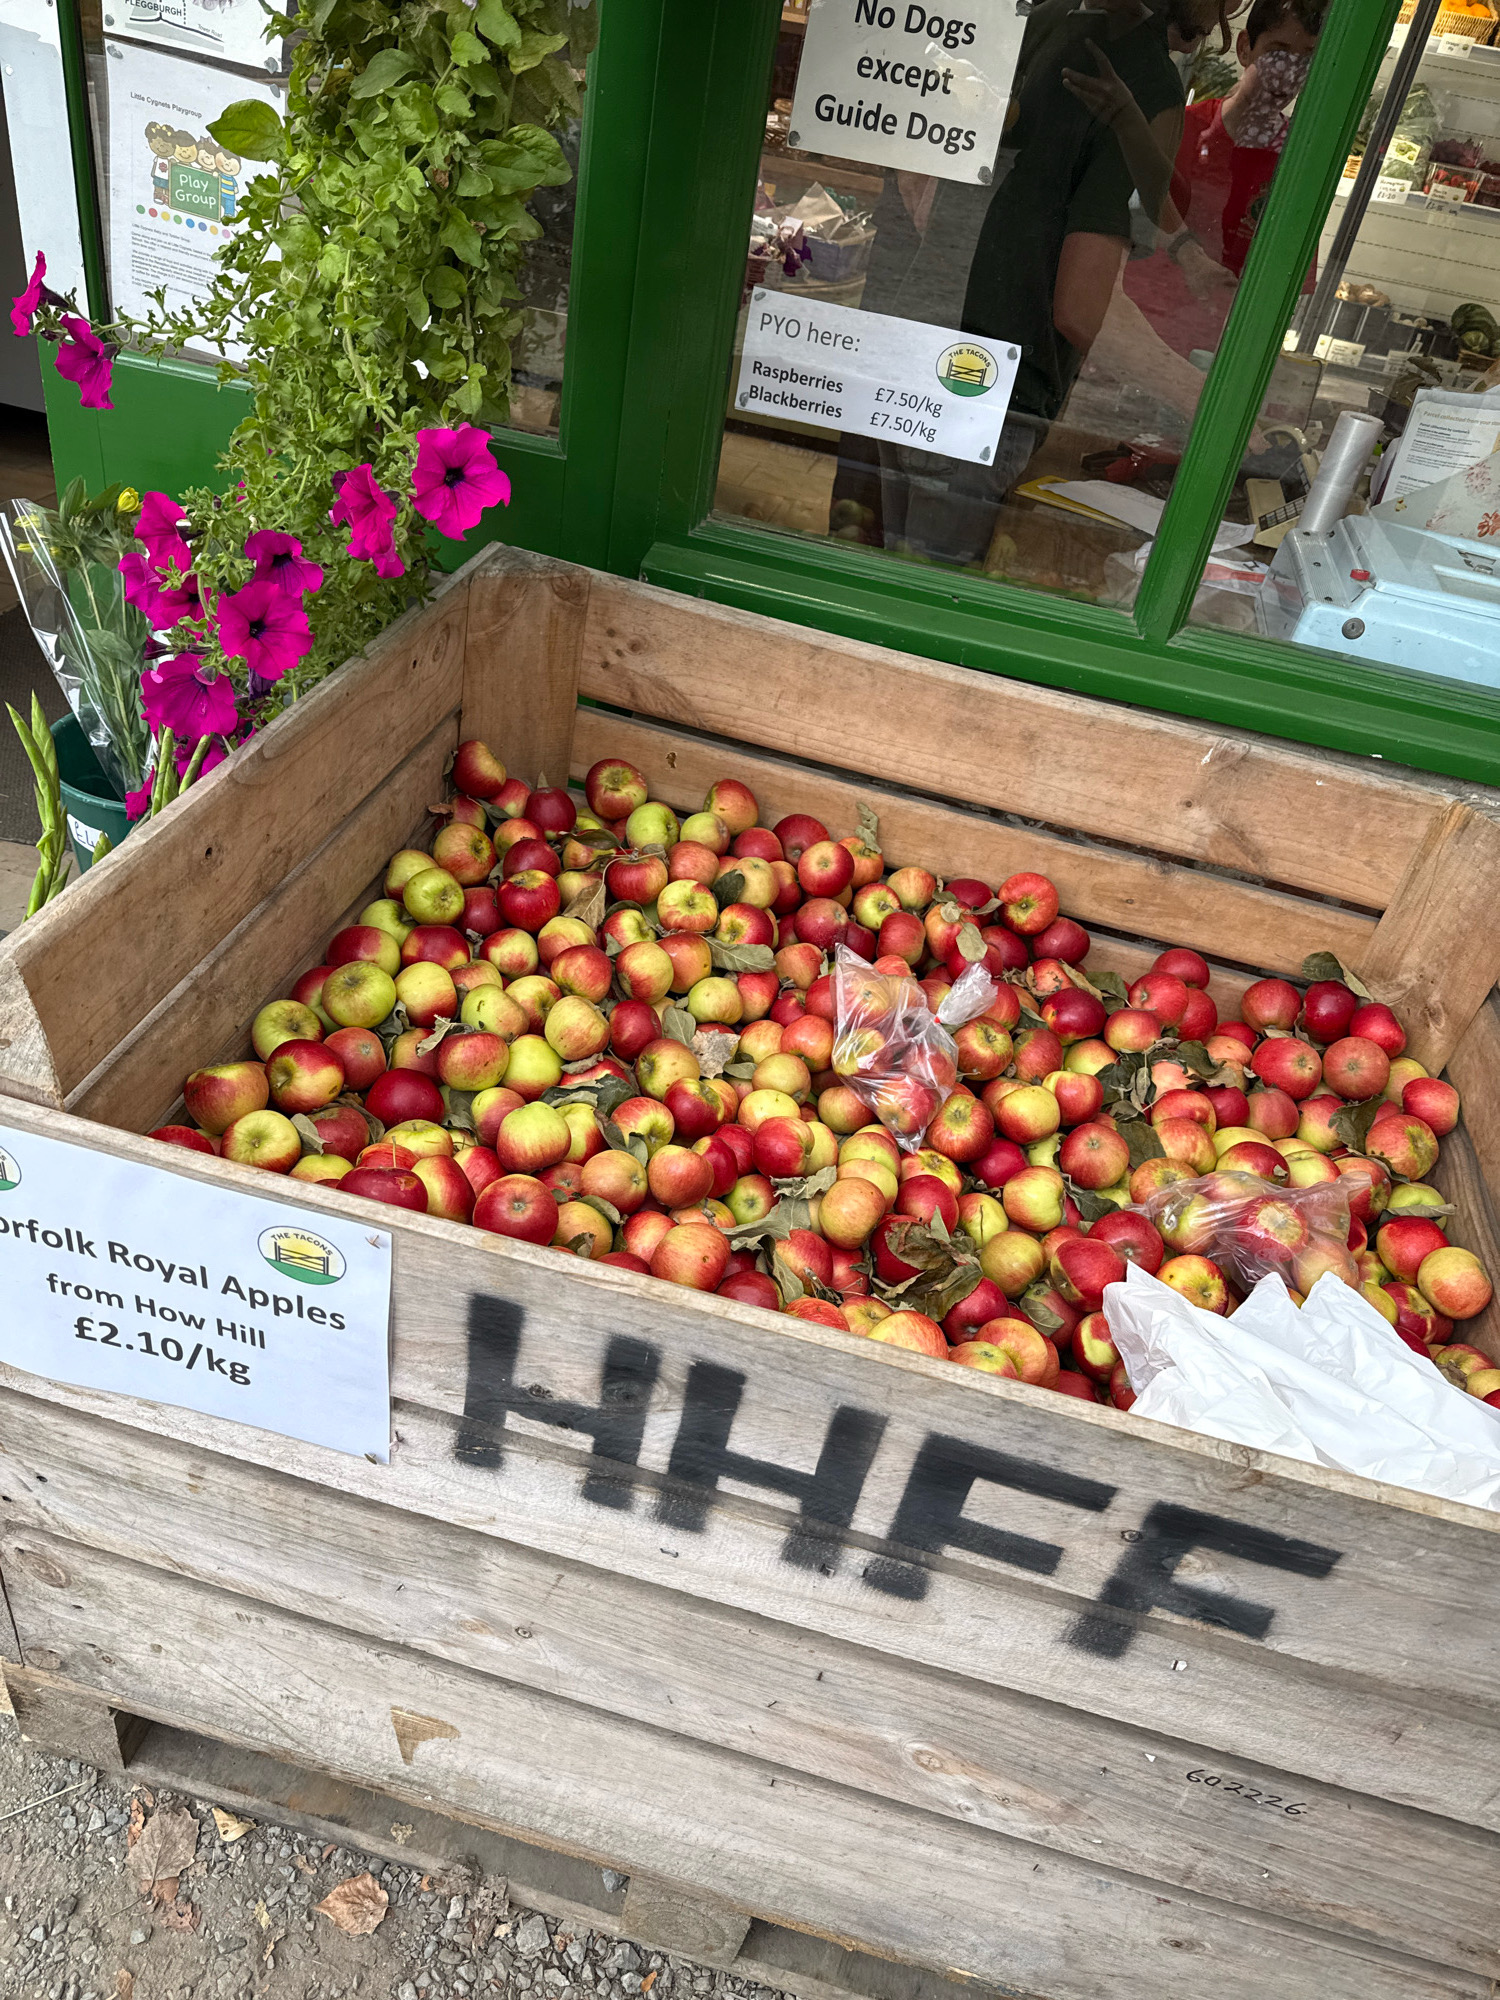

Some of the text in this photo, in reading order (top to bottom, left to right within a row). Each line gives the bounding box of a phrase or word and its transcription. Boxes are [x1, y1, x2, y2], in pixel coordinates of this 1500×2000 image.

[855, 0, 977, 49] No Dogs
[857, 55, 954, 97] except
[131, 91, 202, 118] Little Cygnets Playgroup
[814, 94, 977, 155] Guide Dogs
[175, 189, 217, 209] Group
[180, 174, 209, 193] Play
[759, 312, 861, 352] PYO here:
[948, 349, 991, 368] THE TACONS
[752, 361, 943, 418] Raspberries £7.50/kg
[749, 385, 937, 443] Blackberries £7.50/kg
[270, 1232, 333, 1256] THE TACONS
[108, 1240, 208, 1289] Royal
[220, 1275, 346, 1331] Apples
[46, 1272, 266, 1350] from How Hill
[74, 1315, 251, 1386] £2.10/kg
